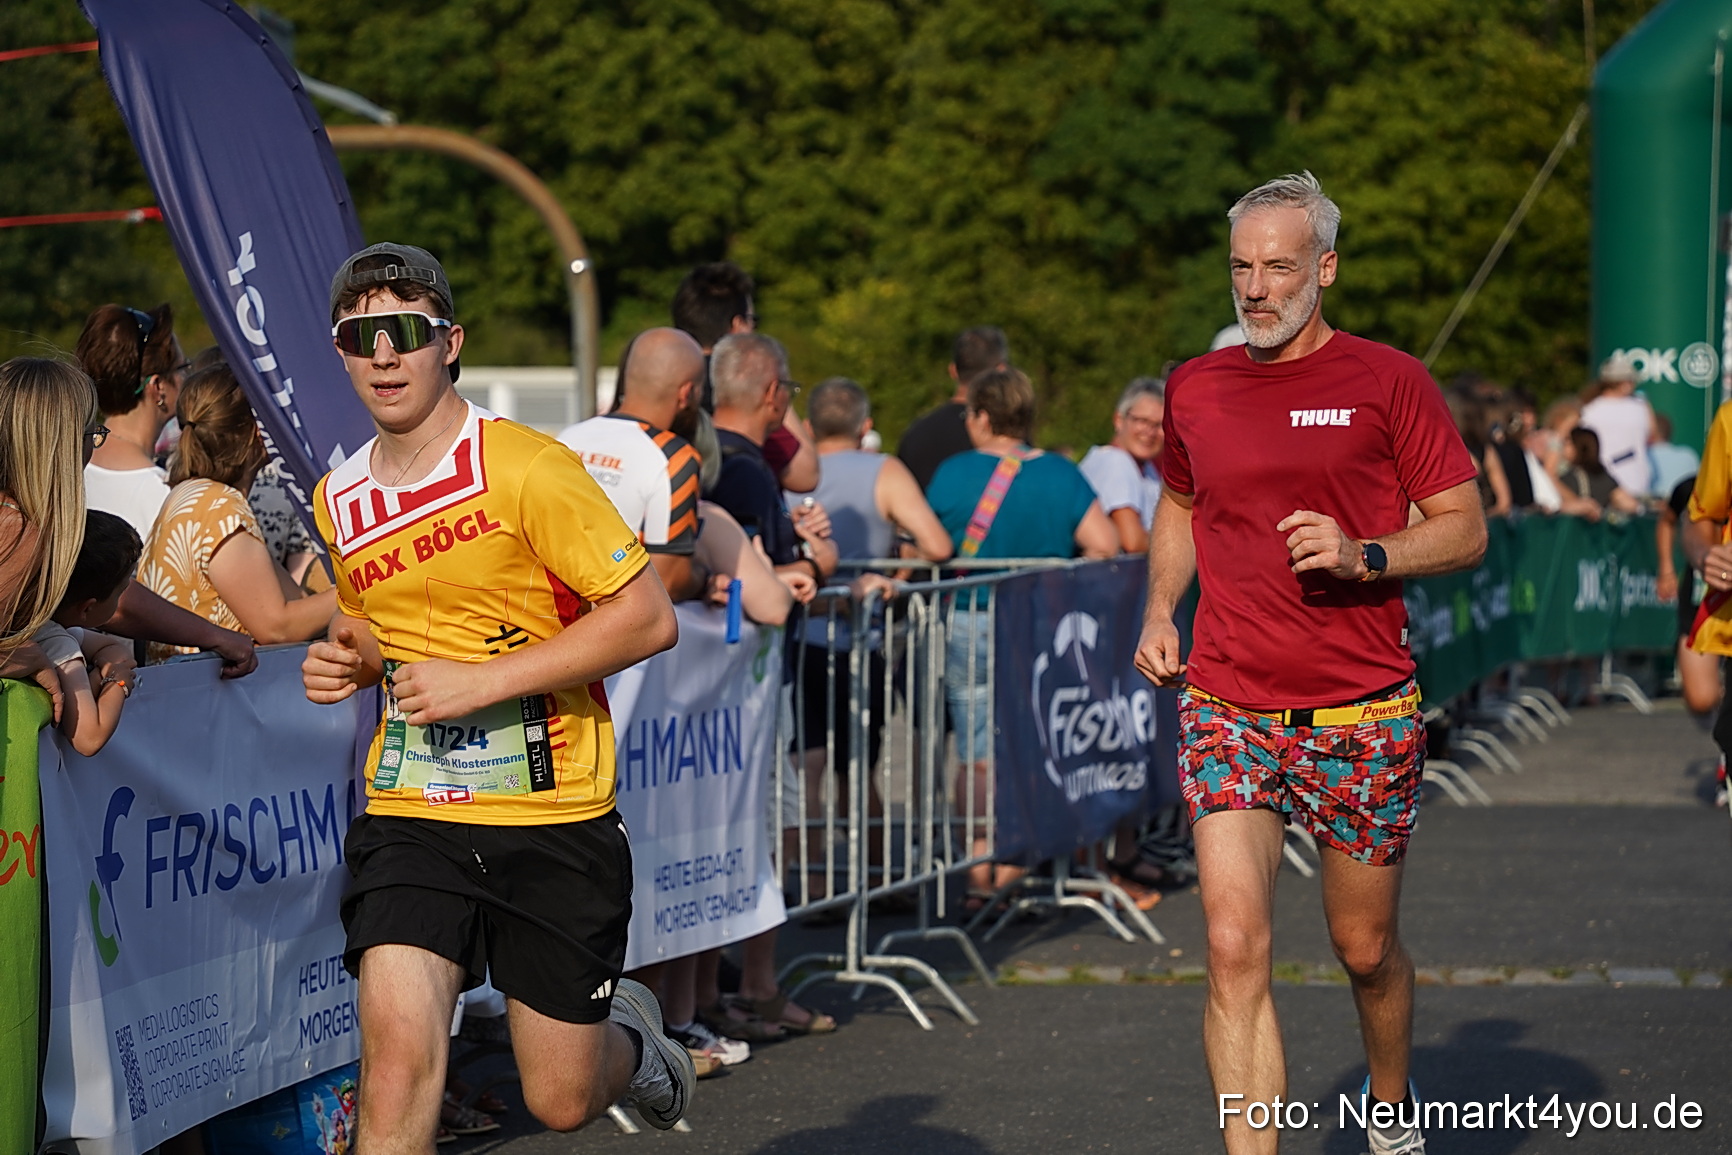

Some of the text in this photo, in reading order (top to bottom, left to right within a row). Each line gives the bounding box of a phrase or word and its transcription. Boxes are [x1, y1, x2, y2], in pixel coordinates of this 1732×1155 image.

[1290, 408, 1352, 427] THULE
[348, 509, 501, 594] MAX BÖGL
[1361, 700, 1415, 718] PowerBar
[427, 723, 489, 751] 1724
[617, 705, 742, 795] HMANN
[406, 750, 525, 768] Christoph Klostermann
[532, 744, 544, 782] HILTL
[654, 860, 691, 892] HEUTE
[654, 901, 704, 936] MORGEN
[299, 954, 345, 998] HEUTE
[138, 993, 219, 1043] MEDIA LOGISTICS
[299, 998, 358, 1049] MORGEN
[144, 1021, 229, 1076] CORPORATE PRINT
[151, 1048, 246, 1109] CORPORATE SIGNAGE
